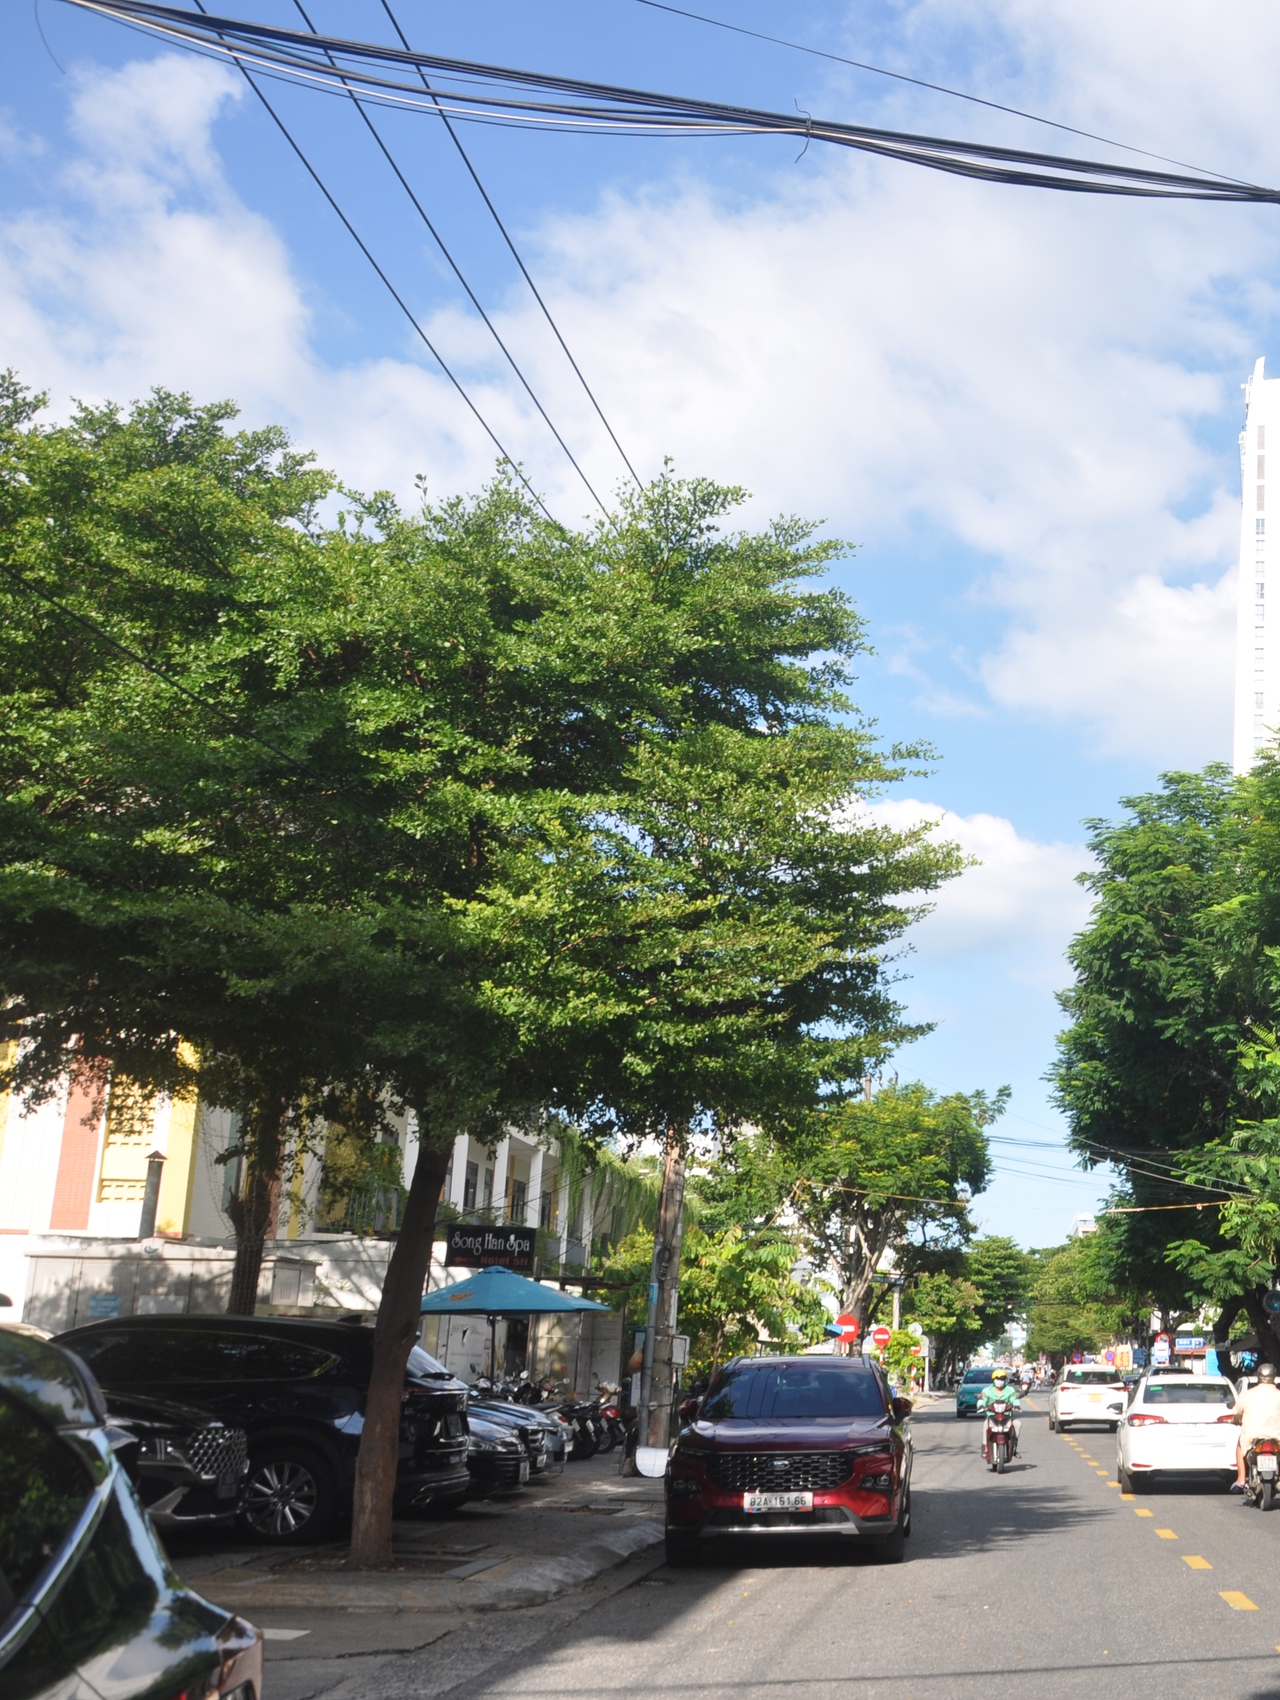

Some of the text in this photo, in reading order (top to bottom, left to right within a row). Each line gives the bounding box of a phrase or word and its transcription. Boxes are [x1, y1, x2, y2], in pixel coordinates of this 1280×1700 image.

[451, 1231, 530, 1256] Song Han Spa
